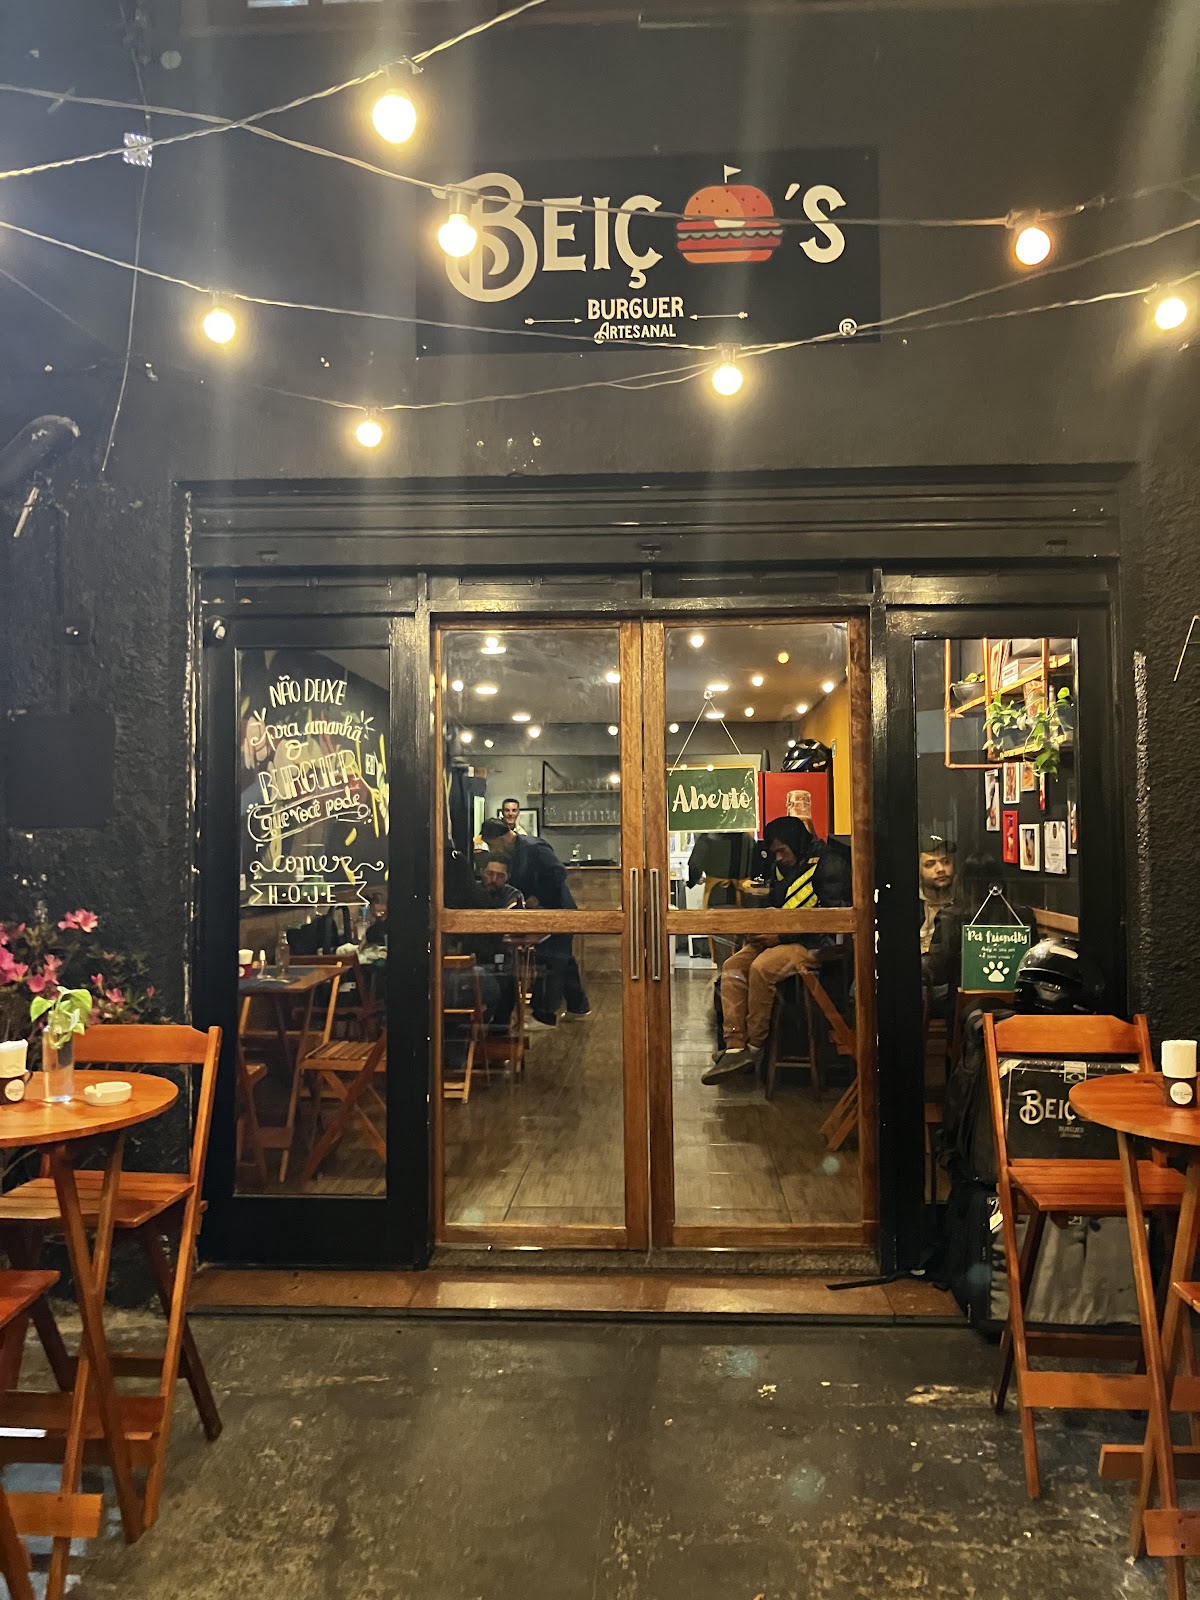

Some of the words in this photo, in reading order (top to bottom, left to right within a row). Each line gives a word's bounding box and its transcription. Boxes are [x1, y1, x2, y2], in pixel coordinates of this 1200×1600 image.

[587, 296, 685, 321] BURGUER
[593, 322, 677, 344] ARTESANAL
[269, 675, 301, 708] NÃO
[304, 678, 348, 706] DEIXE
[251, 721, 301, 751] pra
[301, 714, 364, 742] amanhã
[258, 749, 361, 805] BURGUER
[260, 810, 290, 839] que
[290, 799, 321, 824] você
[326, 786, 361, 817] pode
[672, 784, 752, 813] Aberto
[256, 854, 370, 875] comer
[986, 930, 1027, 944] friendly
